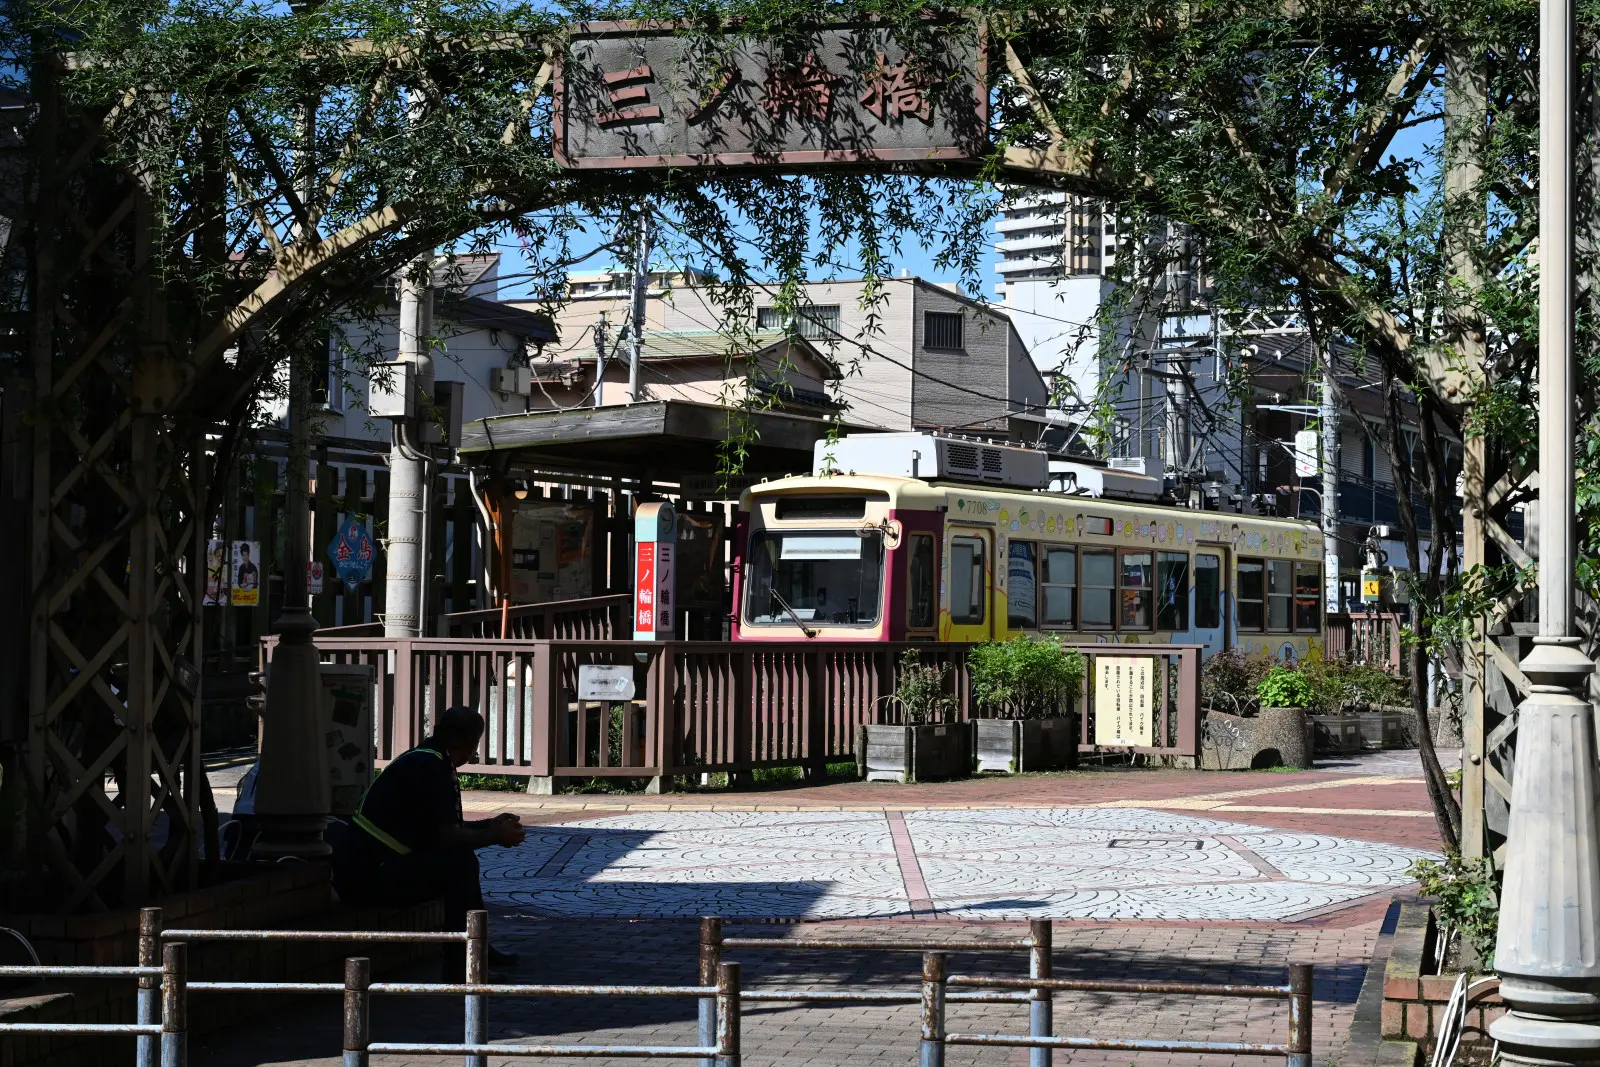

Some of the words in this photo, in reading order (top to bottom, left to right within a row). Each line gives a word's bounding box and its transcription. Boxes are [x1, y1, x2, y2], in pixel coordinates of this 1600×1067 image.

[598, 51, 943, 125] 三ノ輪橋
[967, 500, 988, 516] 7708
[335, 533, 373, 561] 金鳥
[638, 547, 653, 625] 三ノ輪橋
[660, 547, 671, 627] 三ノ輪橋
